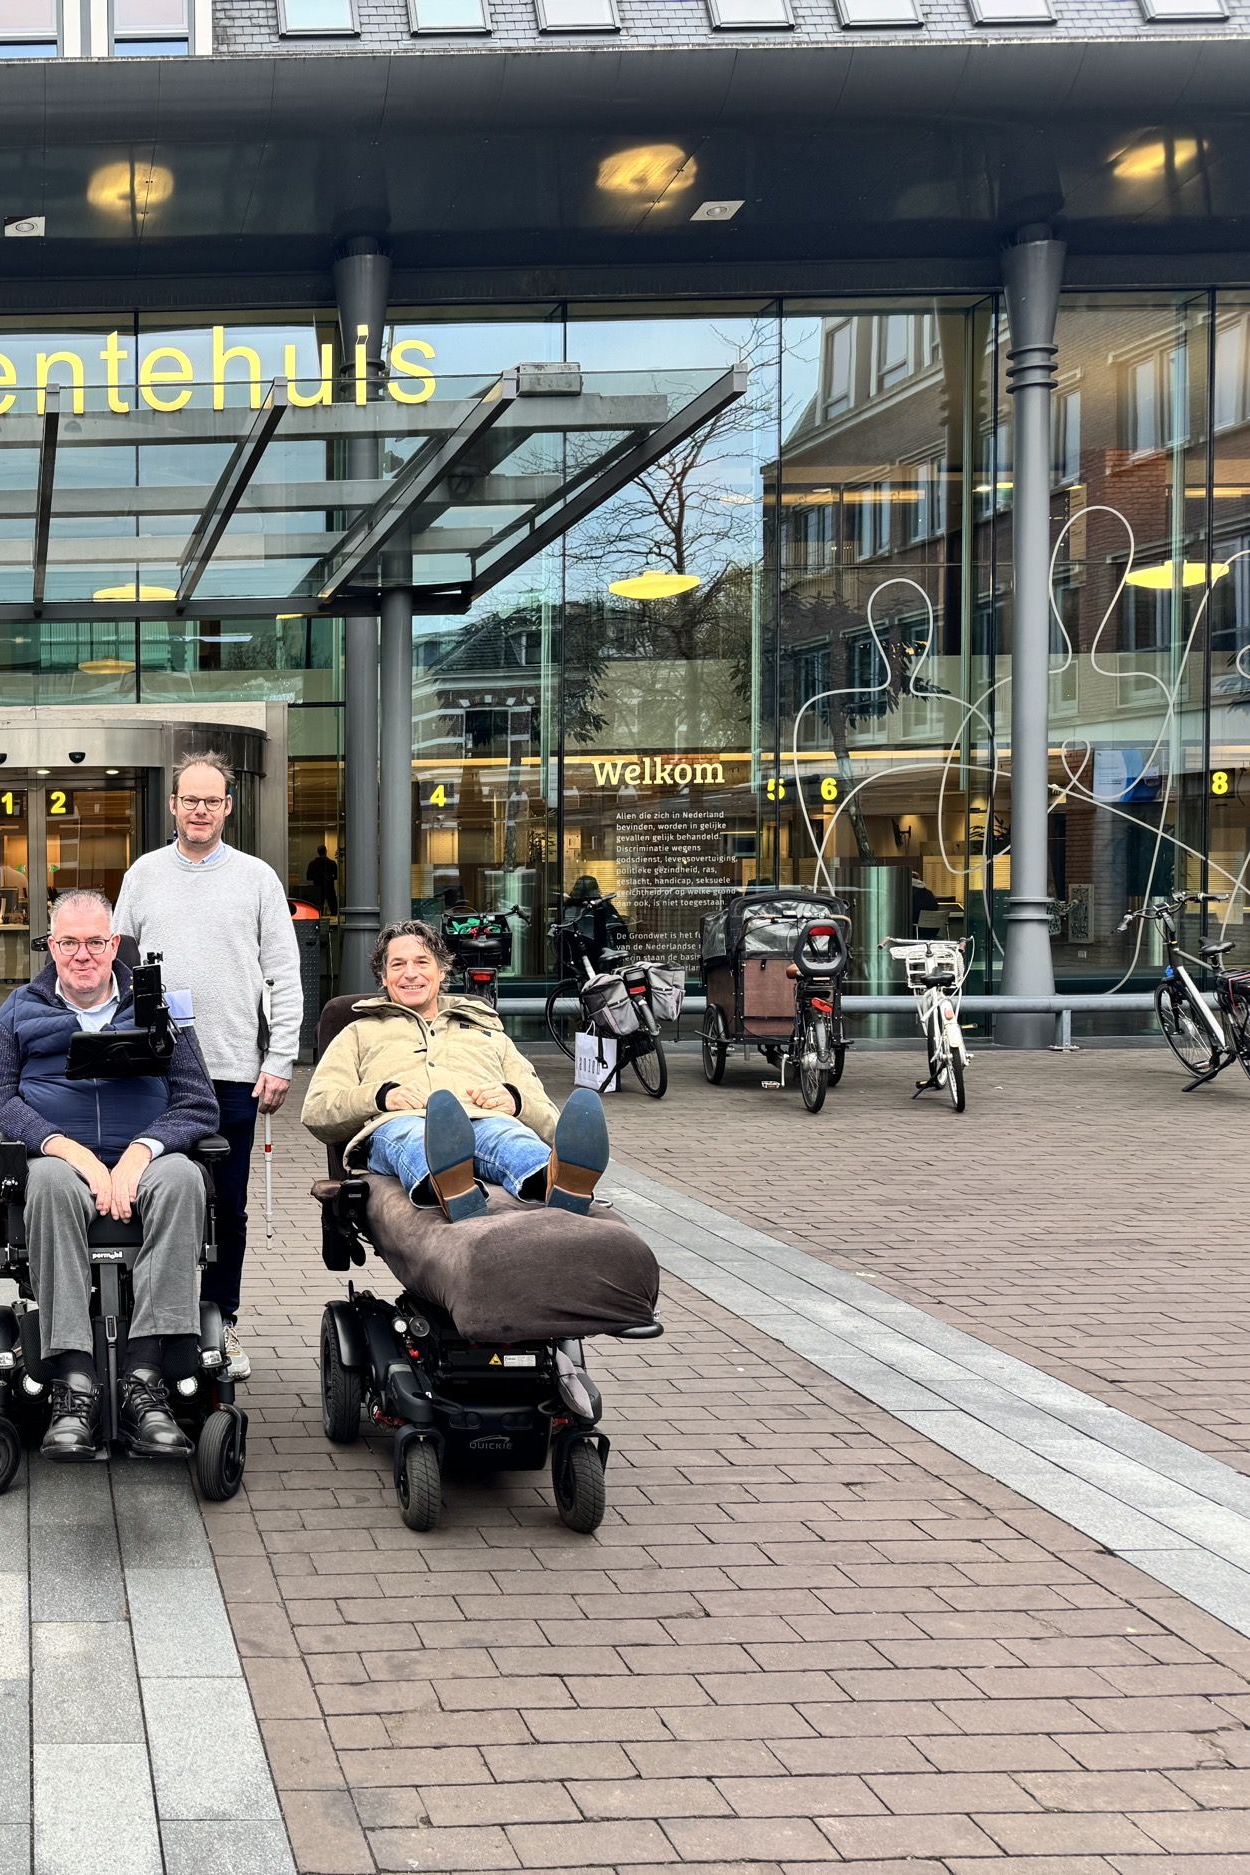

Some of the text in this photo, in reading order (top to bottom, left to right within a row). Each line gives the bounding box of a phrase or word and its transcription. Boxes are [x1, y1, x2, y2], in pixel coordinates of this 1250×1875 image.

[591, 757, 726, 787] Welkom
[1211, 771, 1229, 795] 8
[766, 778, 786, 801] 5
[820, 777, 838, 801] 6
[430, 784, 447, 807] 4
[1, 791, 13, 815] 1
[50, 791, 66, 814] 2
[616, 810, 725, 820] Allen die zich in Nederland
[616, 823, 656, 831] bevinden,
[657, 822, 687, 830] worden
[699, 821, 727, 831] gelijke
[616, 833, 650, 843] gevallen
[652, 833, 674, 842] gelijk
[616, 844, 702, 854] Discriminatie wegens
[616, 855, 663, 865] godsdienst,
[616, 866, 651, 875] politieke
[702, 866, 718, 874] ras,
[654, 877, 694, 886] handicap,
[696, 876, 731, 885] seksuele
[675, 889, 685, 897] op
[712, 888, 737, 897] grond
[633, 899, 651, 908] ook,
[653, 899, 660, 907] is
[662, 898, 679, 907] niet
[616, 932, 627, 940] De
[629, 932, 668, 940] Grondwet
[670, 931, 677, 939] is
[679, 931, 693, 939] het
[633, 943, 643, 951] de
[645, 942, 696, 951] Nederlandse
[667, 953, 678, 961] de
[92, 1250, 123, 1260] permobil
[469, 1442, 512, 1450] QUICKIE
